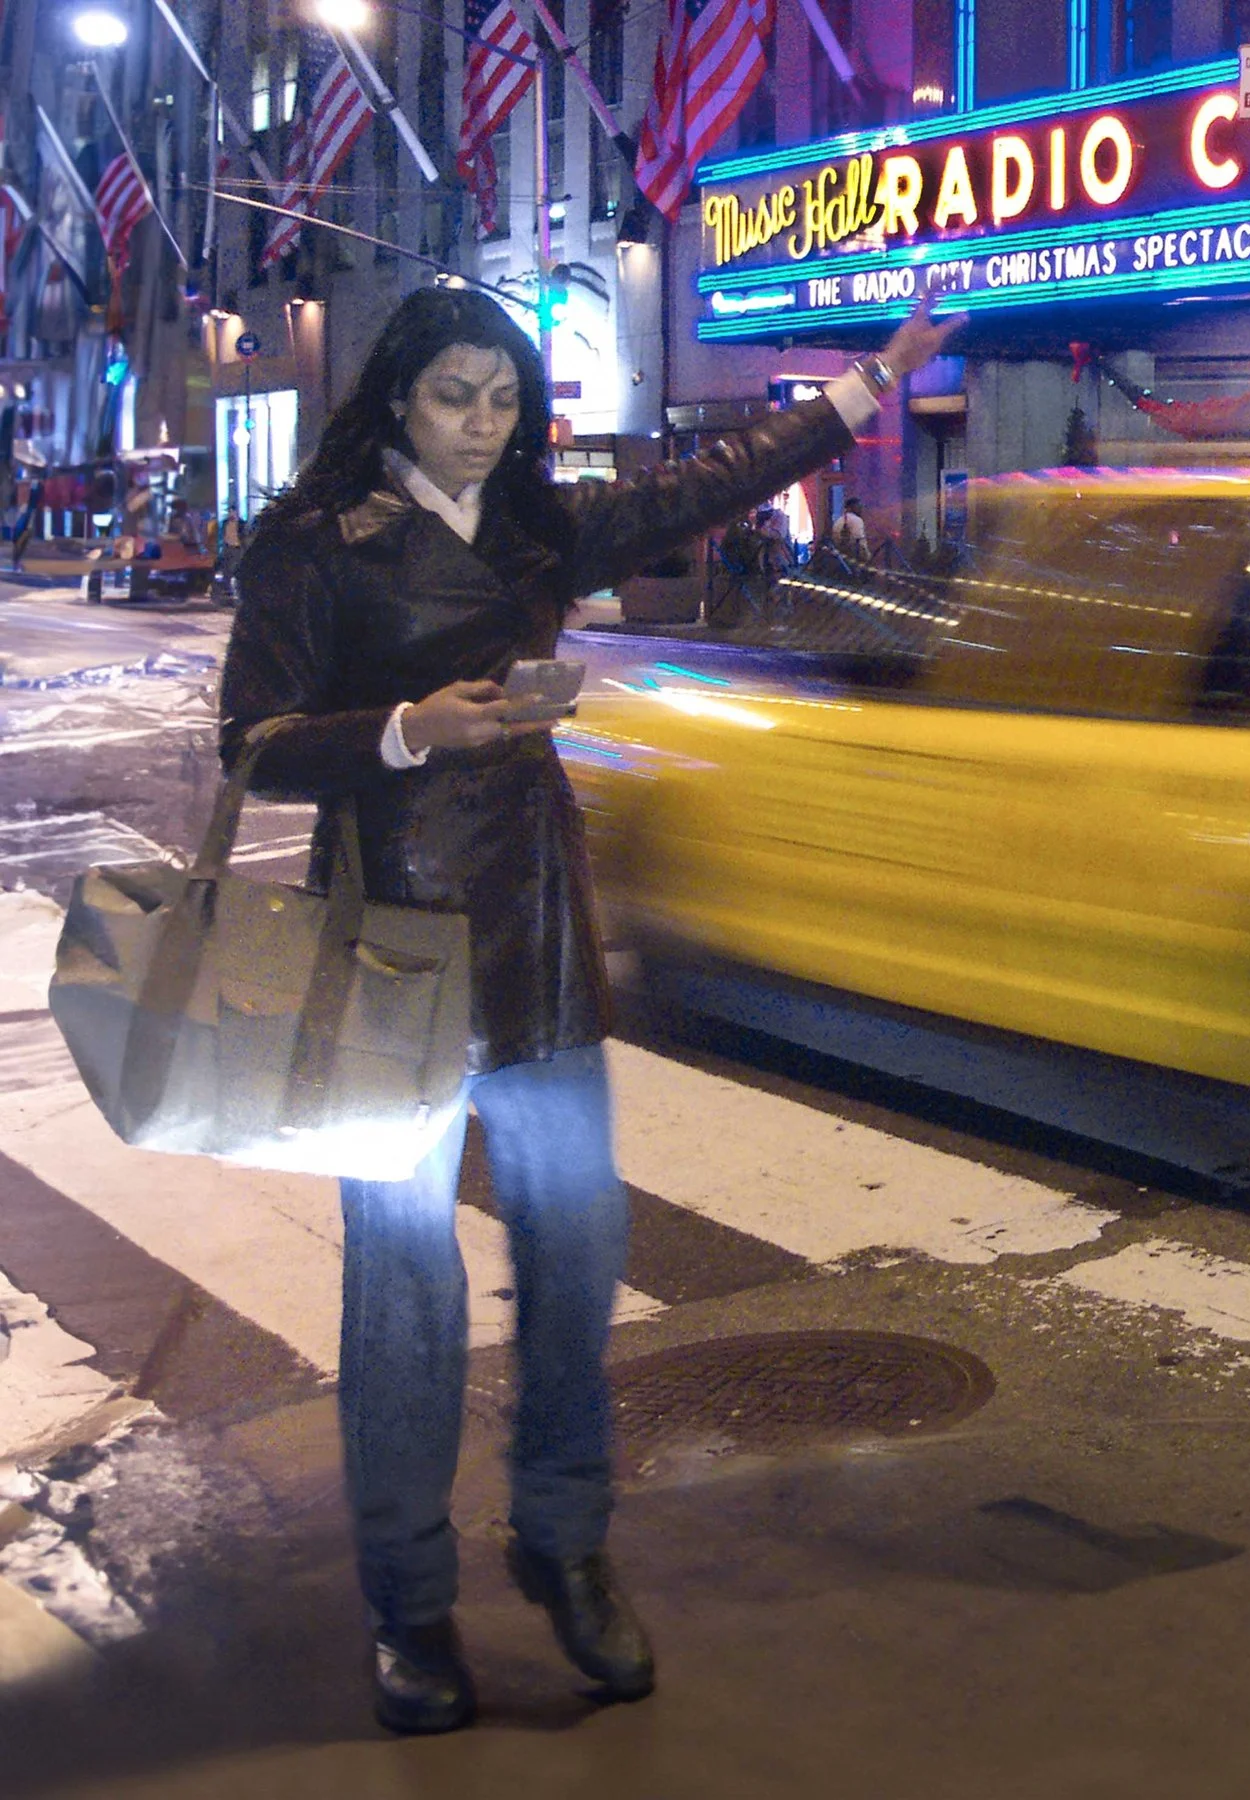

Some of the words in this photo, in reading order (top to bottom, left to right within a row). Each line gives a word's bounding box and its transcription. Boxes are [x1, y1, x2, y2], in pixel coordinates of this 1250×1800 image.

[705, 185, 796, 266] Music
[788, 153, 876, 260] Hall
[883, 114, 1134, 236] RADIO
[808, 276, 841, 308] THE
[853, 267, 915, 304] RADIO
[986, 244, 1117, 291] CHRISTMAS
